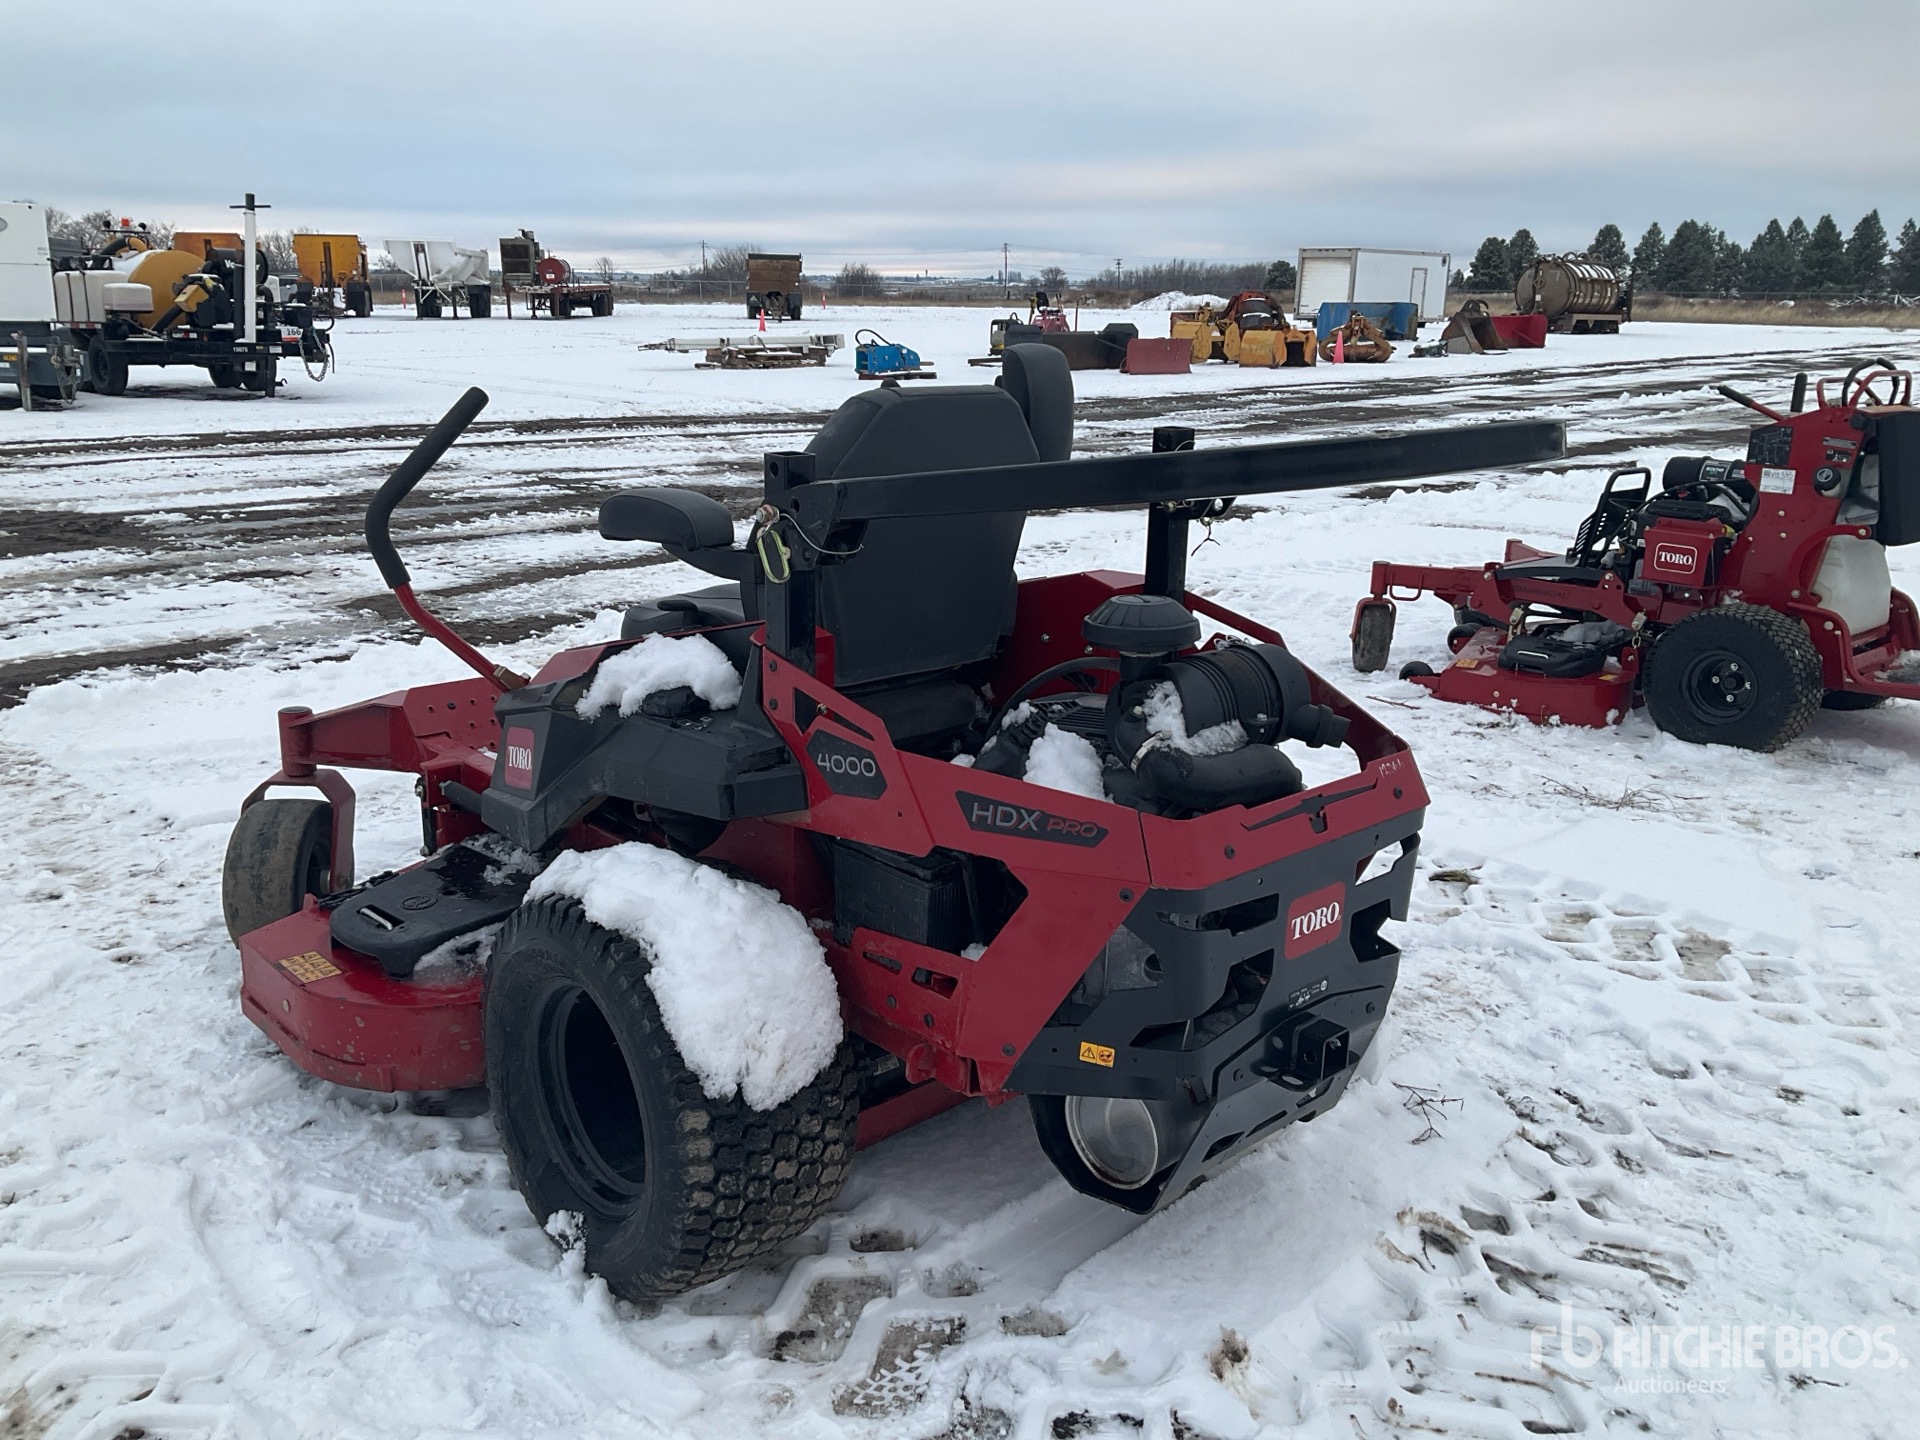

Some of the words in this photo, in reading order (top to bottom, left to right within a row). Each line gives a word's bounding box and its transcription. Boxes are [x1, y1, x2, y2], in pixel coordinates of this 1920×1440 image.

[1659, 551, 1693, 566] TORO
[508, 745, 533, 771] TORO
[817, 753, 876, 777] 4000
[971, 802, 1043, 832] HDX
[1047, 817, 1099, 838] PRO
[1291, 901, 1341, 940] TORO
